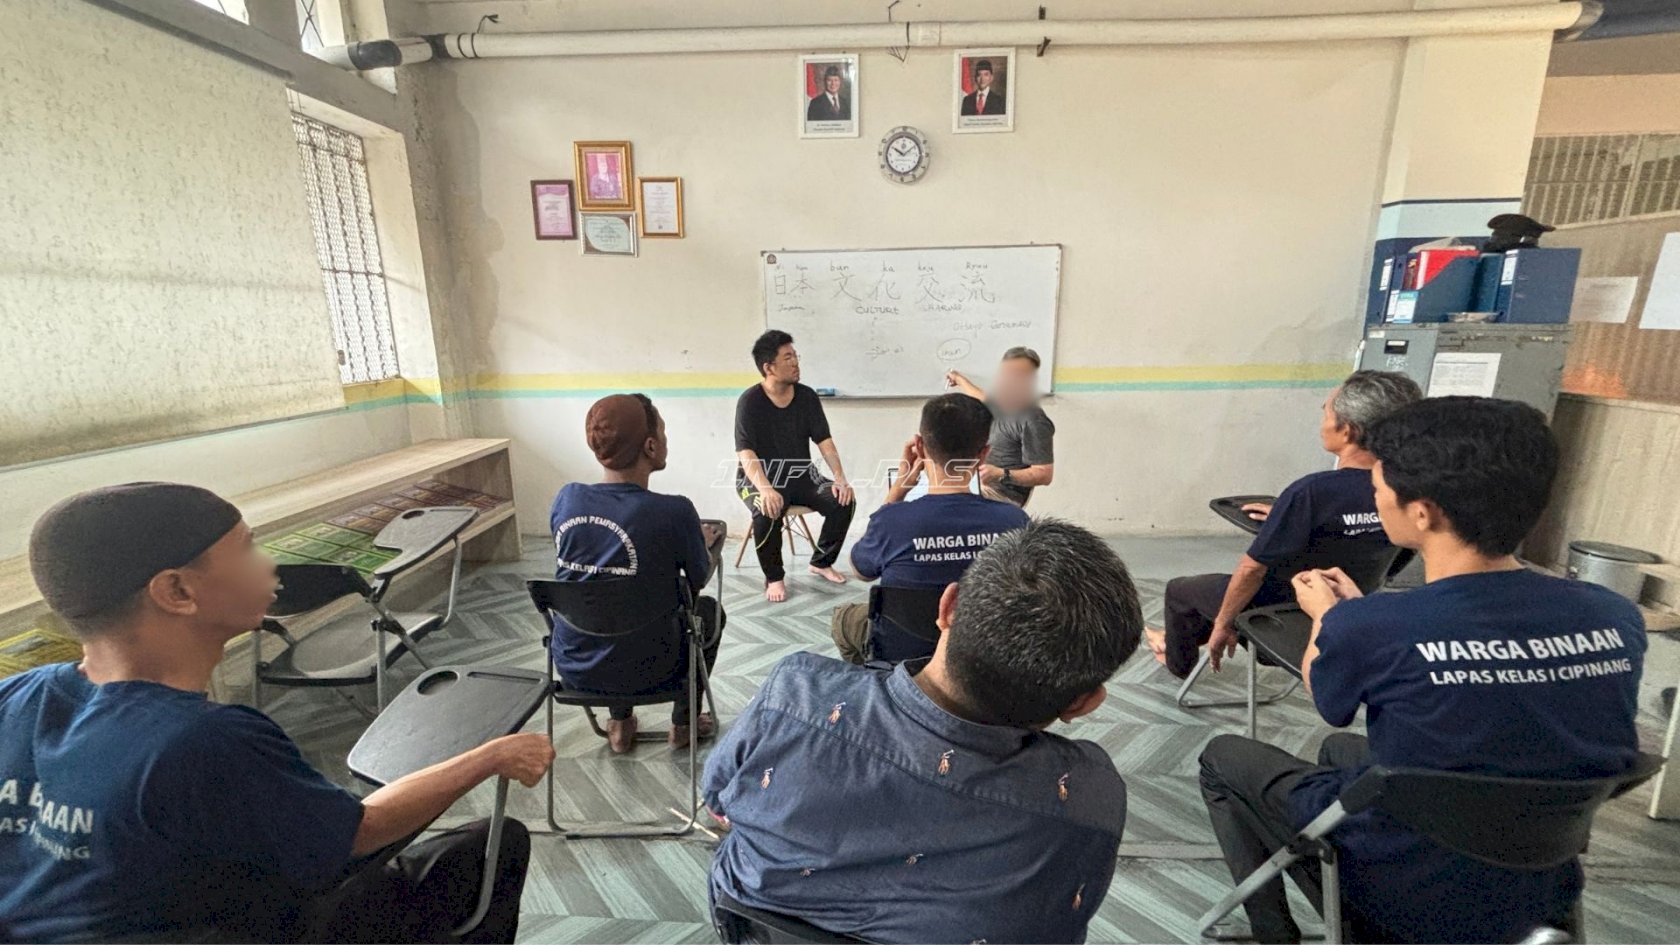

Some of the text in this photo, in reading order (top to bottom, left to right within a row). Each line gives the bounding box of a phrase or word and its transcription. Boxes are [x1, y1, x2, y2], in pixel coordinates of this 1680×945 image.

[830, 260, 851, 272] bun
[855, 305, 900, 315] CULTURE
[912, 533, 1000, 551] WARGA BINA
[913, 552, 942, 562] LAPAS
[944, 550, 972, 562] KELAS
[1416, 628, 1625, 662] WARGA BINAAN
[1429, 657, 1632, 686] LAPAS KELAS I CIPINANG
